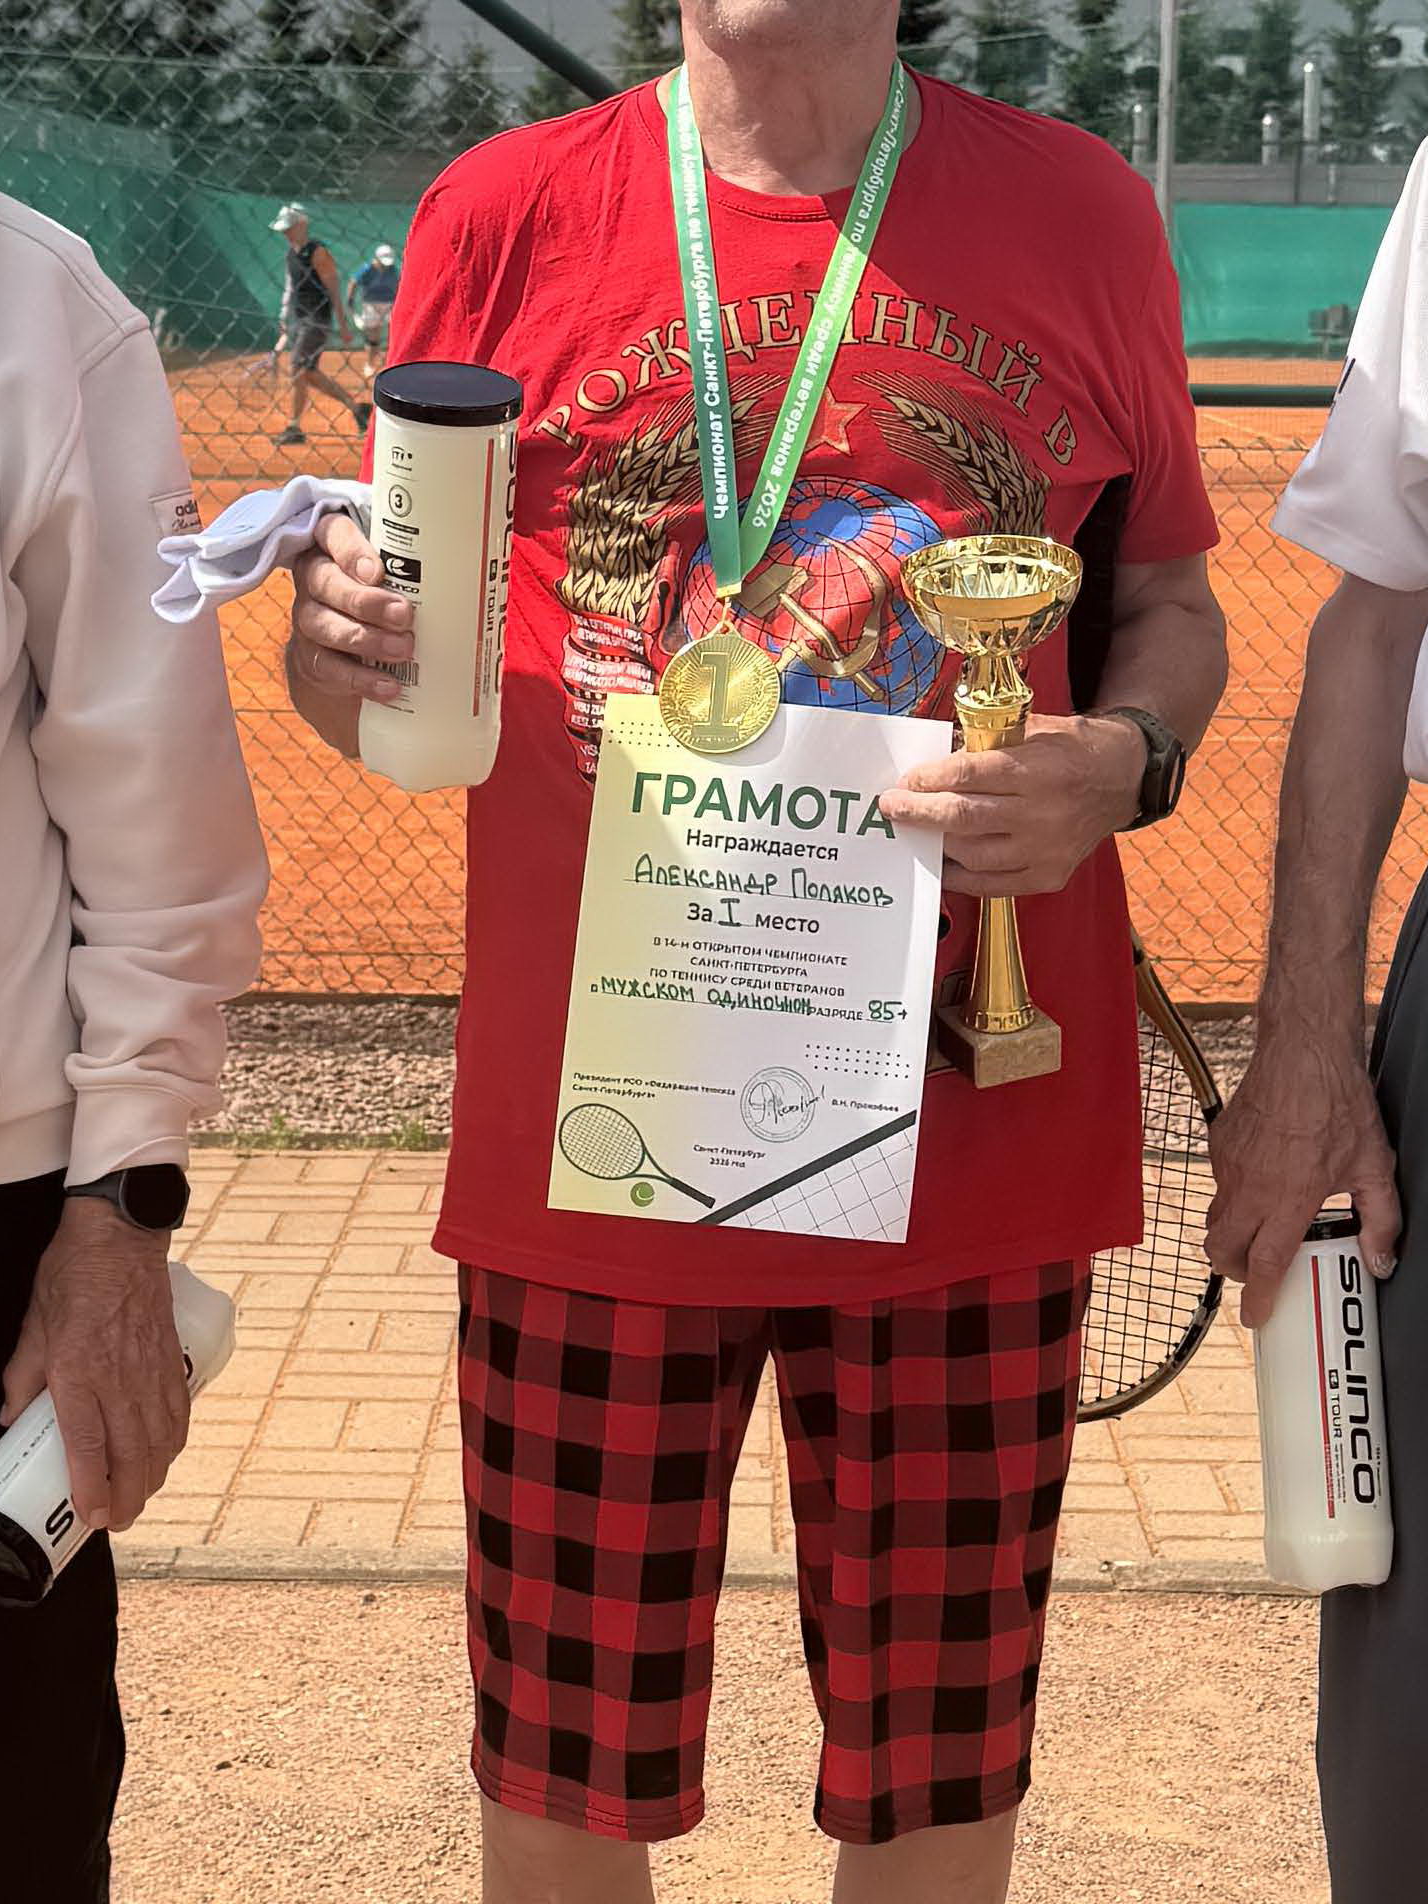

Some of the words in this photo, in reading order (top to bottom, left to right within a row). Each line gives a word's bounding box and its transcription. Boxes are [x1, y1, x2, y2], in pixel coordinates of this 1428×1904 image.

[689, 241, 721, 407] Санкт-Петербурга
[1042, 409, 1079, 466] В
[708, 411, 730, 520] Чемпионат
[752, 480, 781, 528] 2026
[692, 651, 740, 737] 1
[631, 772, 897, 839] ГРАМОТА
[687, 829, 839, 861] Награждается
[687, 903, 712, 923] За
[755, 912, 820, 933] место
[690, 956, 808, 977] САНКТ-ПЕТЕРБУРГА
[692, 941, 763, 957] ОТКРЫТОМ
[765, 948, 848, 966] ЧЕМПИОНАТЕ
[601, 976, 695, 1002] МУЖСКОМ
[811, 1006, 863, 1021] РАЗРЯДЕ
[868, 999, 908, 1022] 85+
[650, 968, 668, 978] ПО
[671, 969, 727, 985] ТЕННИСУ
[730, 976, 771, 990] СРЕДИ
[774, 980, 845, 997] ВЕТЕРАНОВ
[1338, 1254, 1376, 1505] SOLINCO
[1329, 1393, 1343, 1439] TOUR
